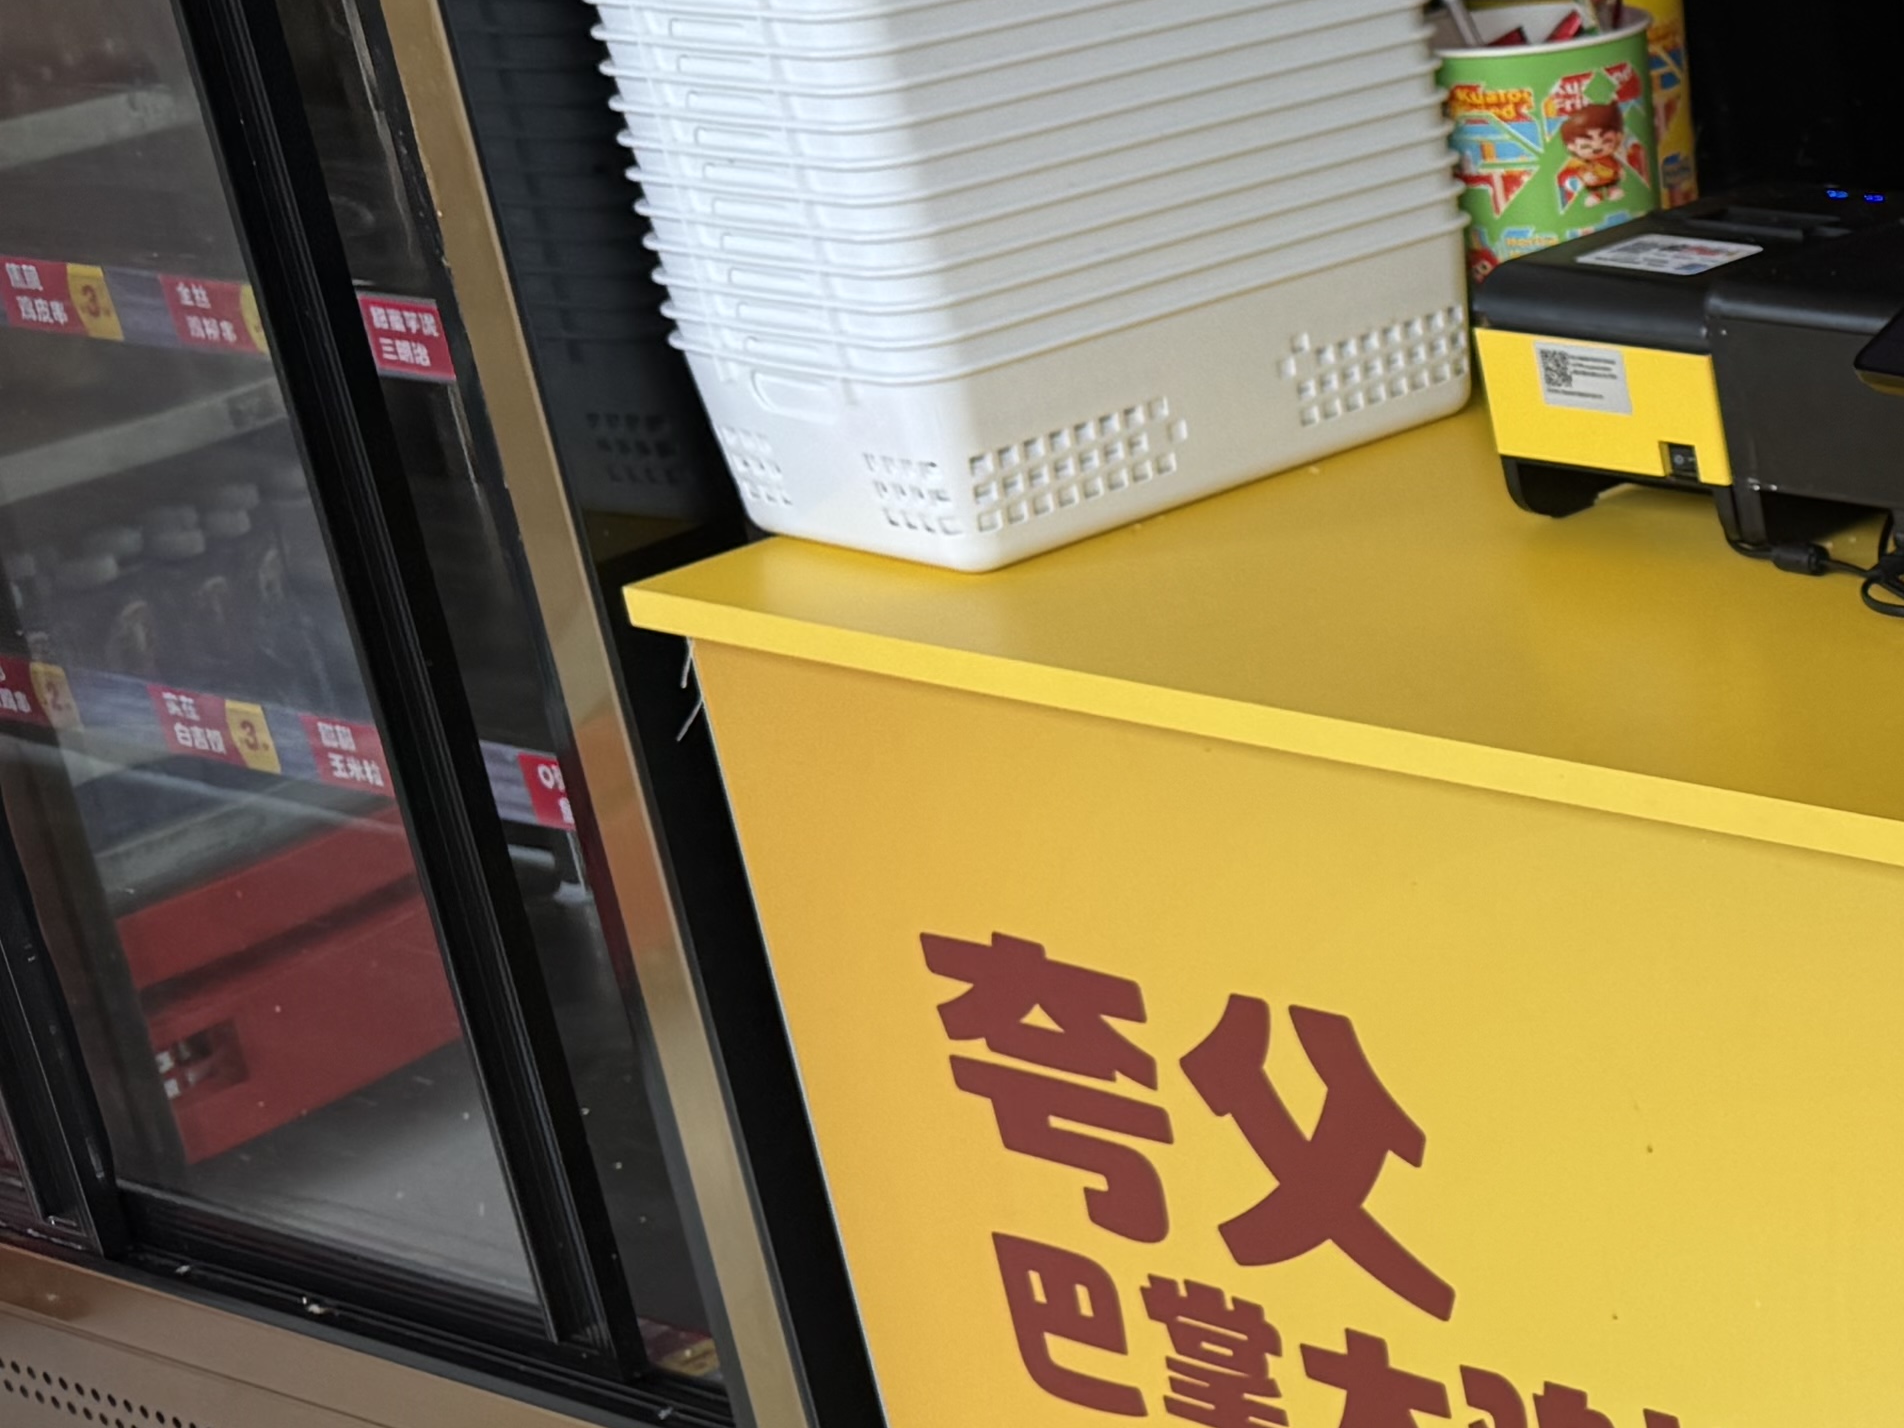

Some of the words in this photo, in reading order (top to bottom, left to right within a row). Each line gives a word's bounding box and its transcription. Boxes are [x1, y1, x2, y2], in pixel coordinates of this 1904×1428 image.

[327, 752, 384, 787] 玉米粒
[919, 932, 1456, 1322] 夸父
